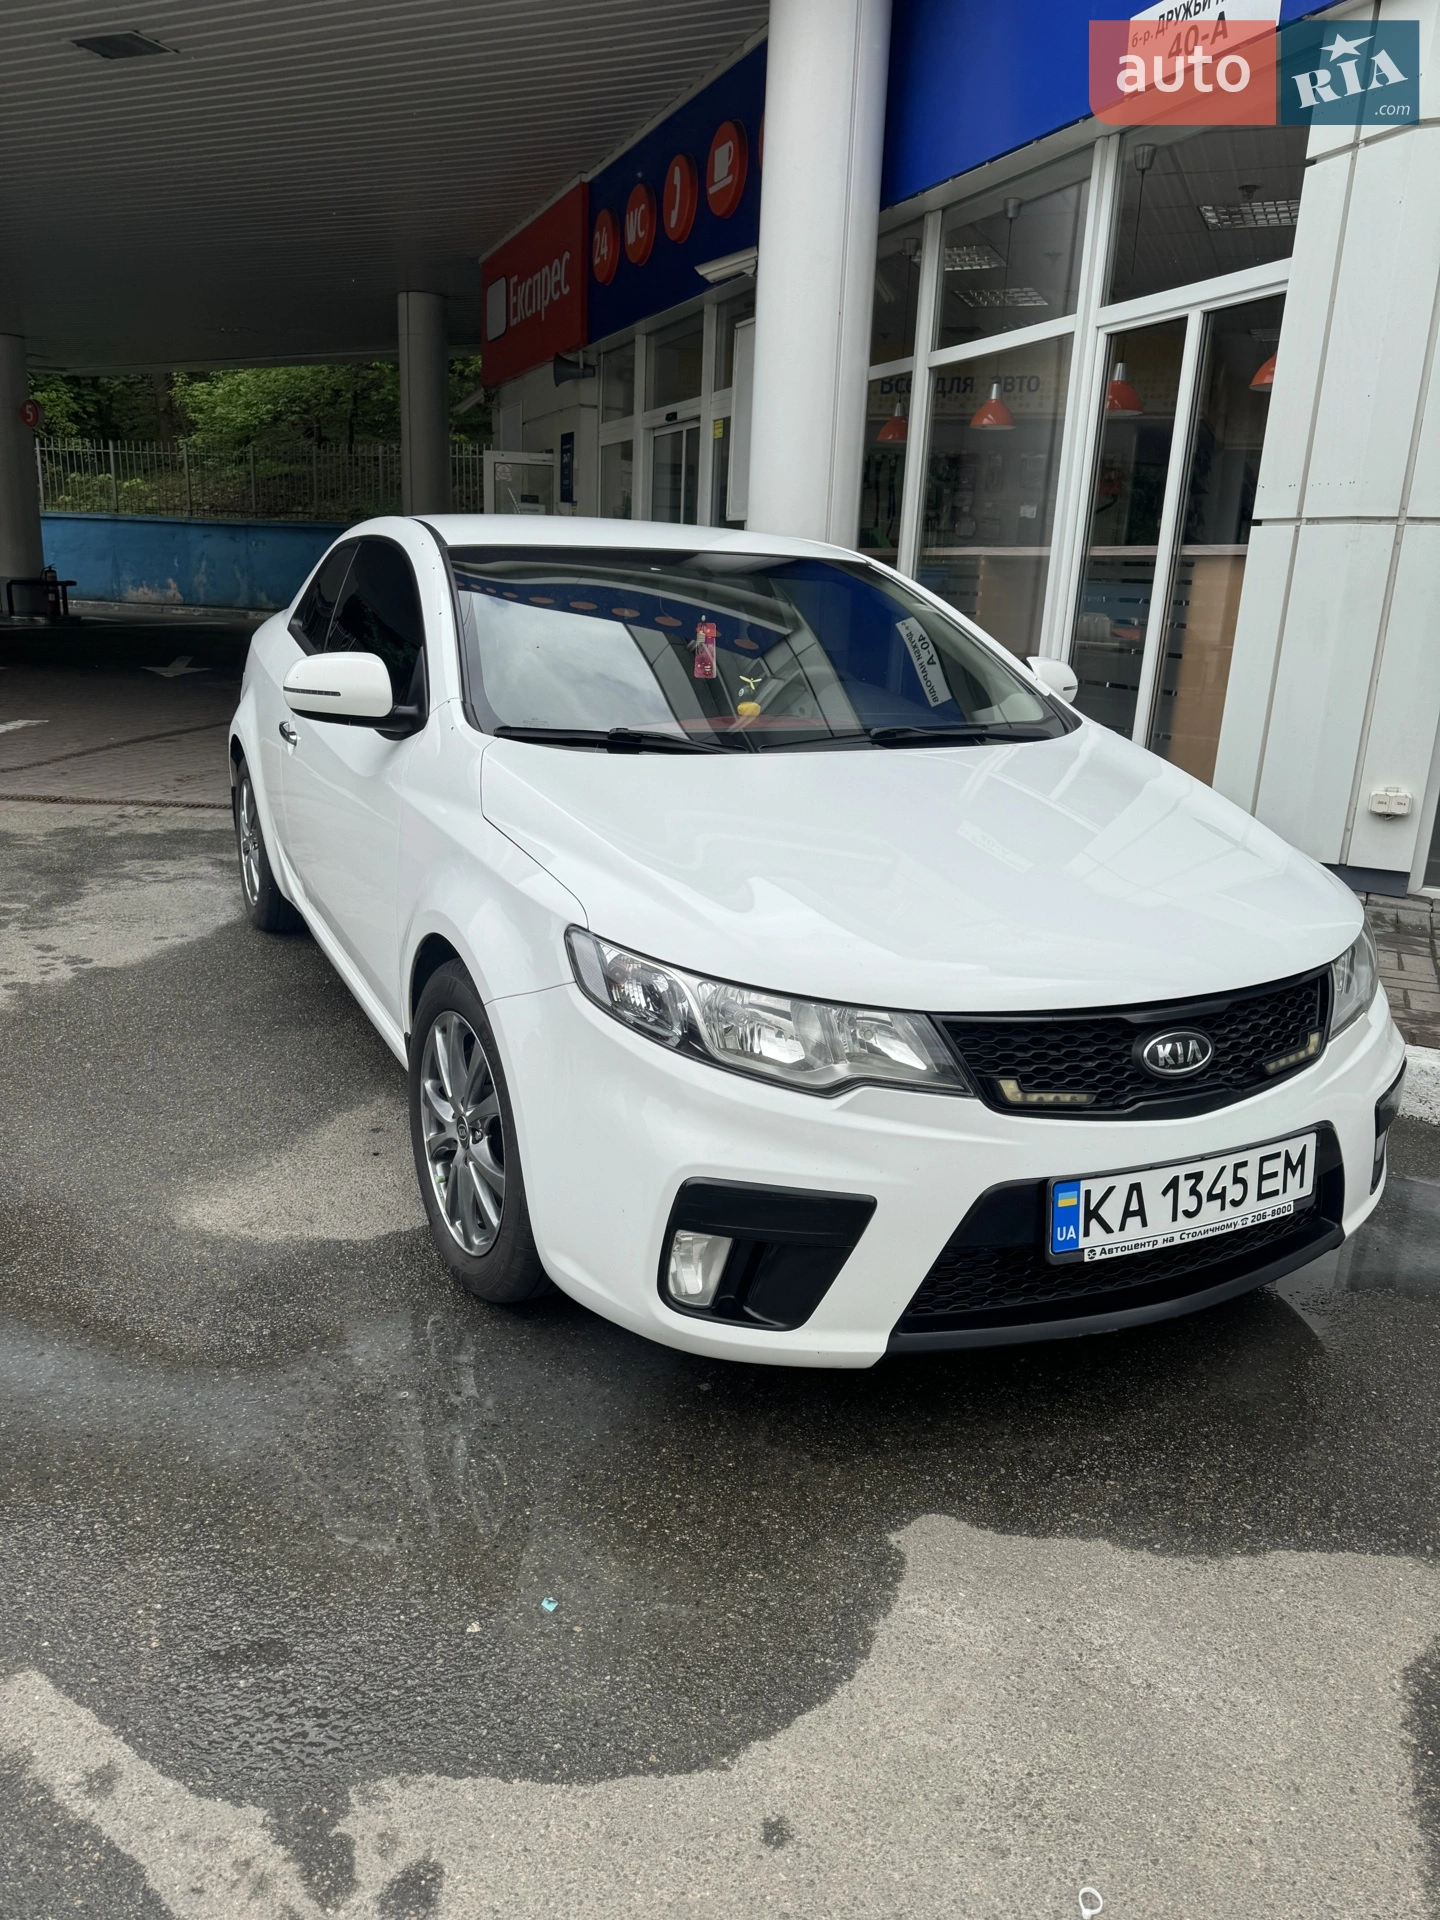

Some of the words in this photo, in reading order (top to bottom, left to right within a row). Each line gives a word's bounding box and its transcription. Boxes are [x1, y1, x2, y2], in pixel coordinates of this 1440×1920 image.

[625, 203, 646, 245] WC
[593, 226, 608, 266] 24
[509, 250, 570, 328] Експрес
[937, 376, 975, 398] для
[26, 404, 34, 422] 5
[1156, 1039, 1203, 1067] KIA
[1160, 1160, 1249, 1223] 1345
[1056, 1224, 1077, 1242] UA
[1098, 1238, 1158, 1257] Автоцентр
[1162, 1235, 1175, 1245] на
[1179, 1220, 1239, 1241] Столичному
[1250, 1203, 1292, 1224] 206-8000
